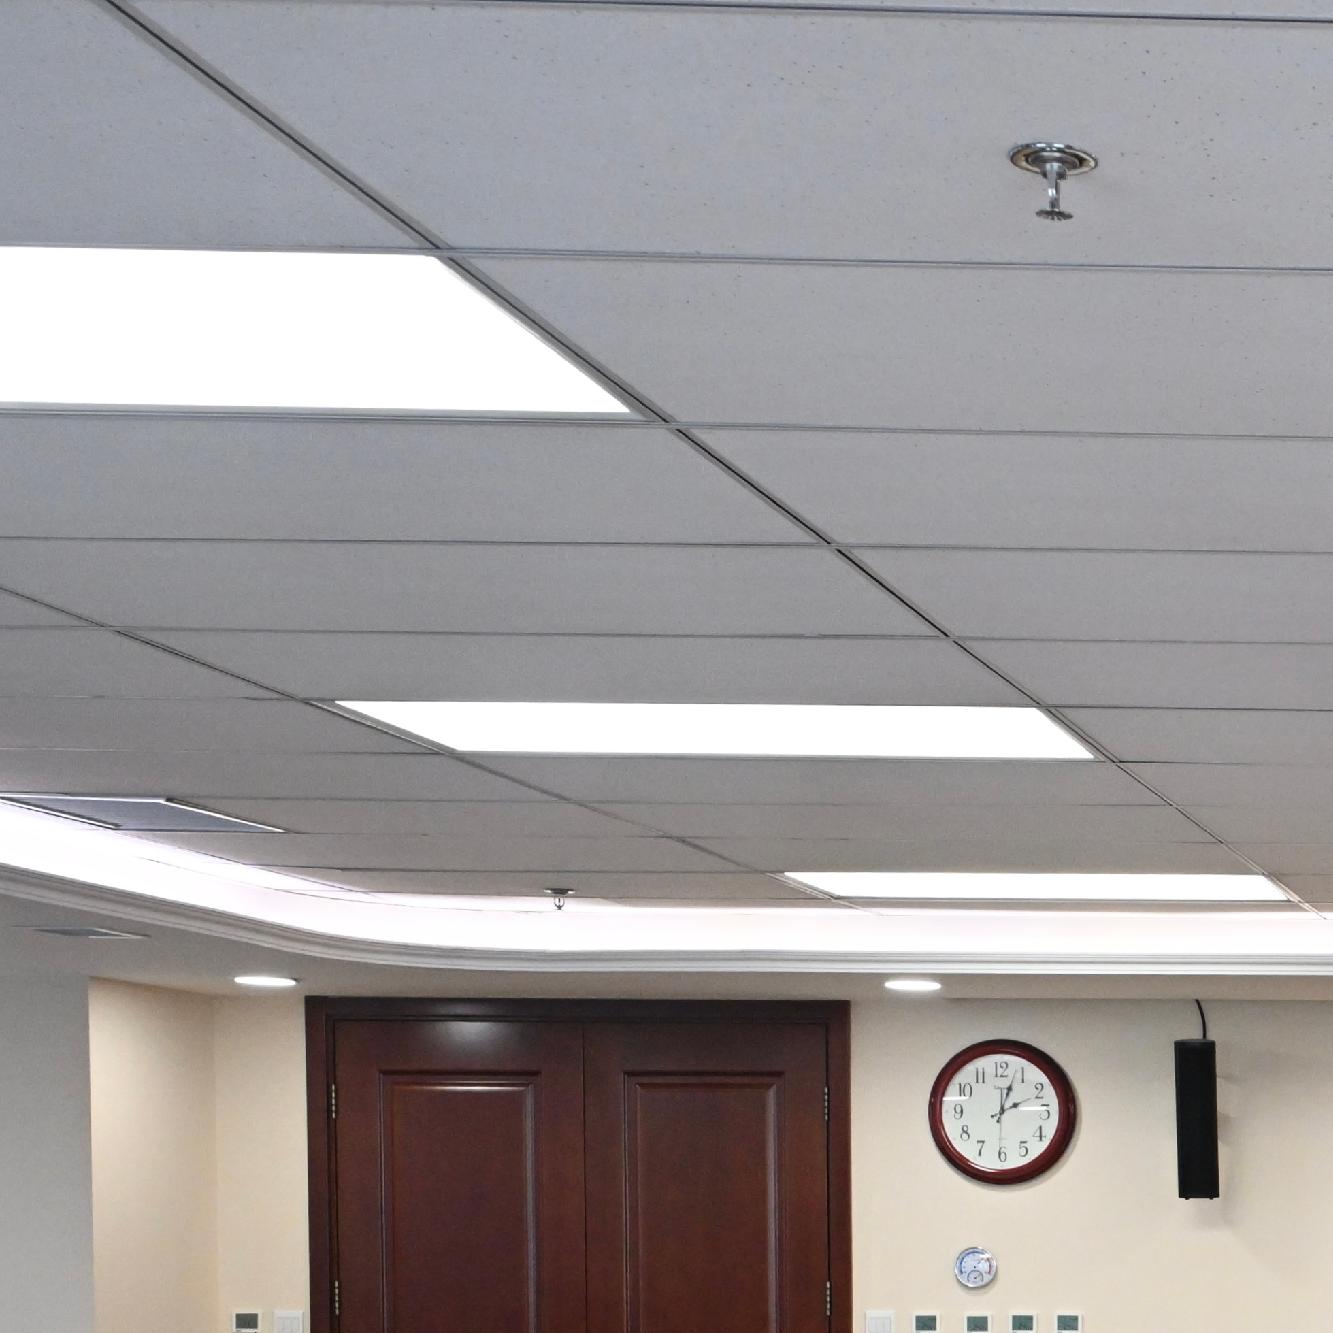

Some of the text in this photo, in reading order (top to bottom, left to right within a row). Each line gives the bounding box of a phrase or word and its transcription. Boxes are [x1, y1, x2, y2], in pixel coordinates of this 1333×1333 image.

[975, 1067, 986, 1084] 11
[994, 1061, 1009, 1078] 12
[1019, 1067, 1025, 1083] 1
[958, 1082, 973, 1098] 10
[1034, 1083, 1044, 1099] 2
[953, 1104, 964, 1120] 9
[960, 1125, 970, 1141] 8
[1032, 1125, 1046, 1142] 4
[976, 1140, 985, 1157] 7
[997, 1147, 1007, 1162] 6
[1019, 1141, 1029, 1157] 5
